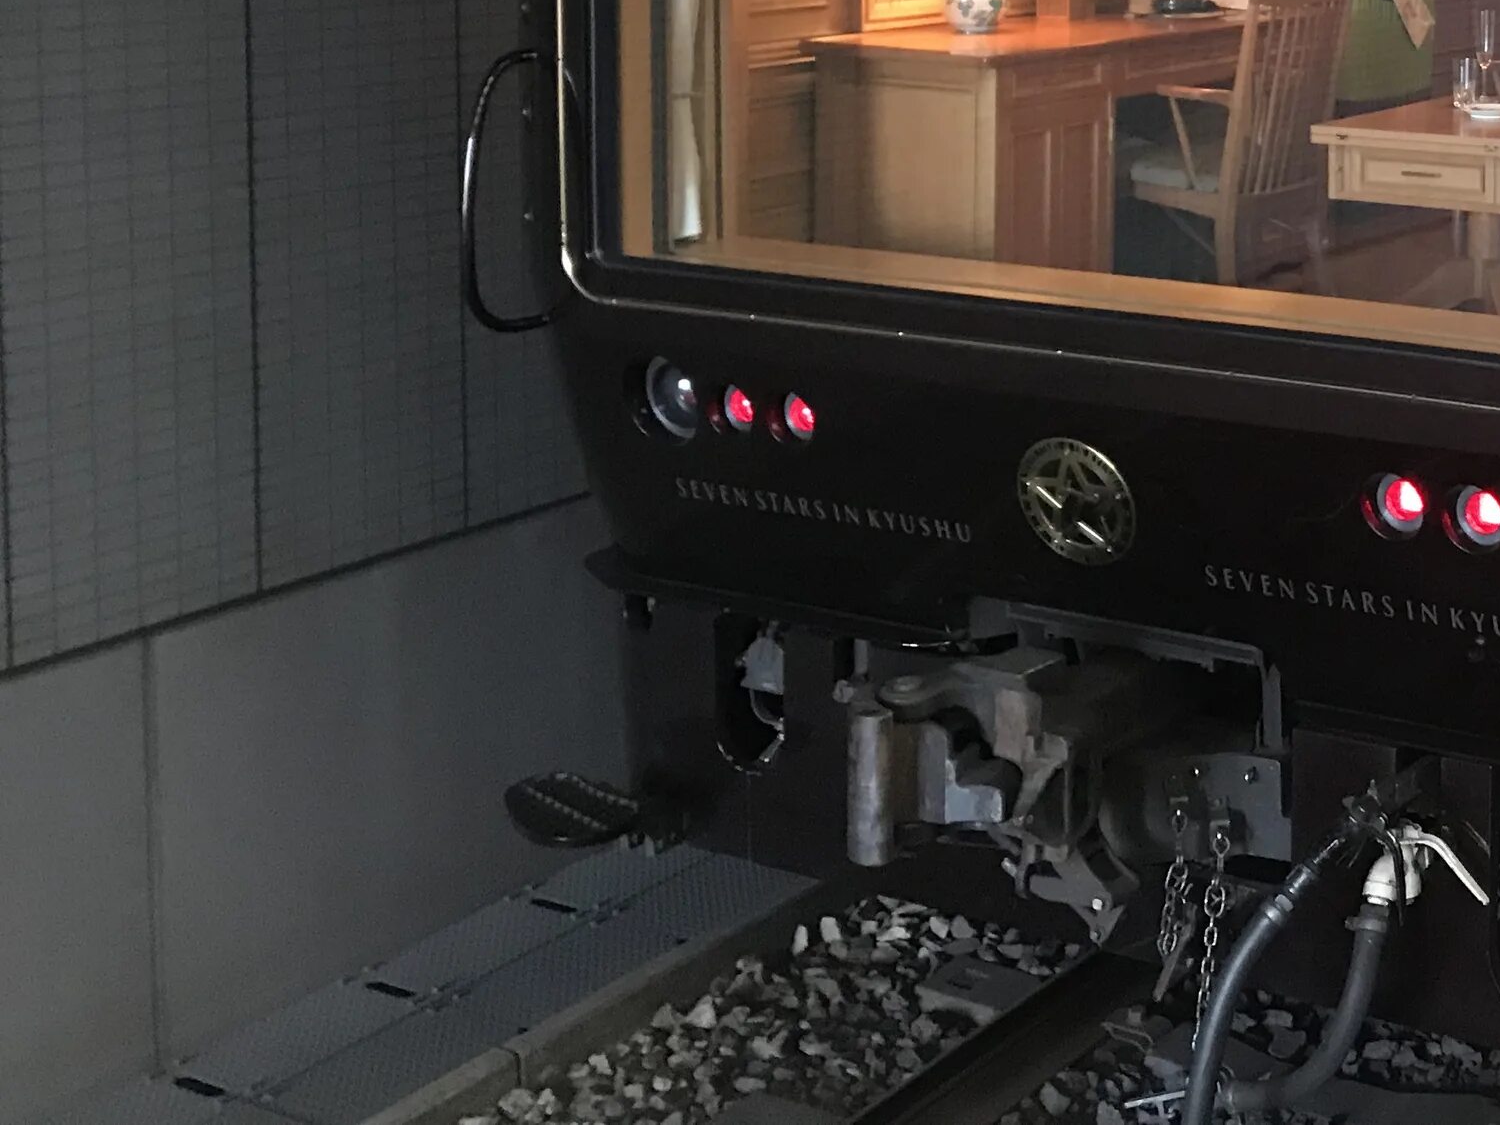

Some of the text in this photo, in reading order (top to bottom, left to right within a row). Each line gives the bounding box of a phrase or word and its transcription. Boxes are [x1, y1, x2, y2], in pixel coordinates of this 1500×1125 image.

[674, 476, 973, 544] SEVEN STARS IN KYUSHU
[1203, 563, 1296, 601] SEVEN
[1304, 579, 1396, 619] STARS
[1405, 598, 1440, 627] IN
